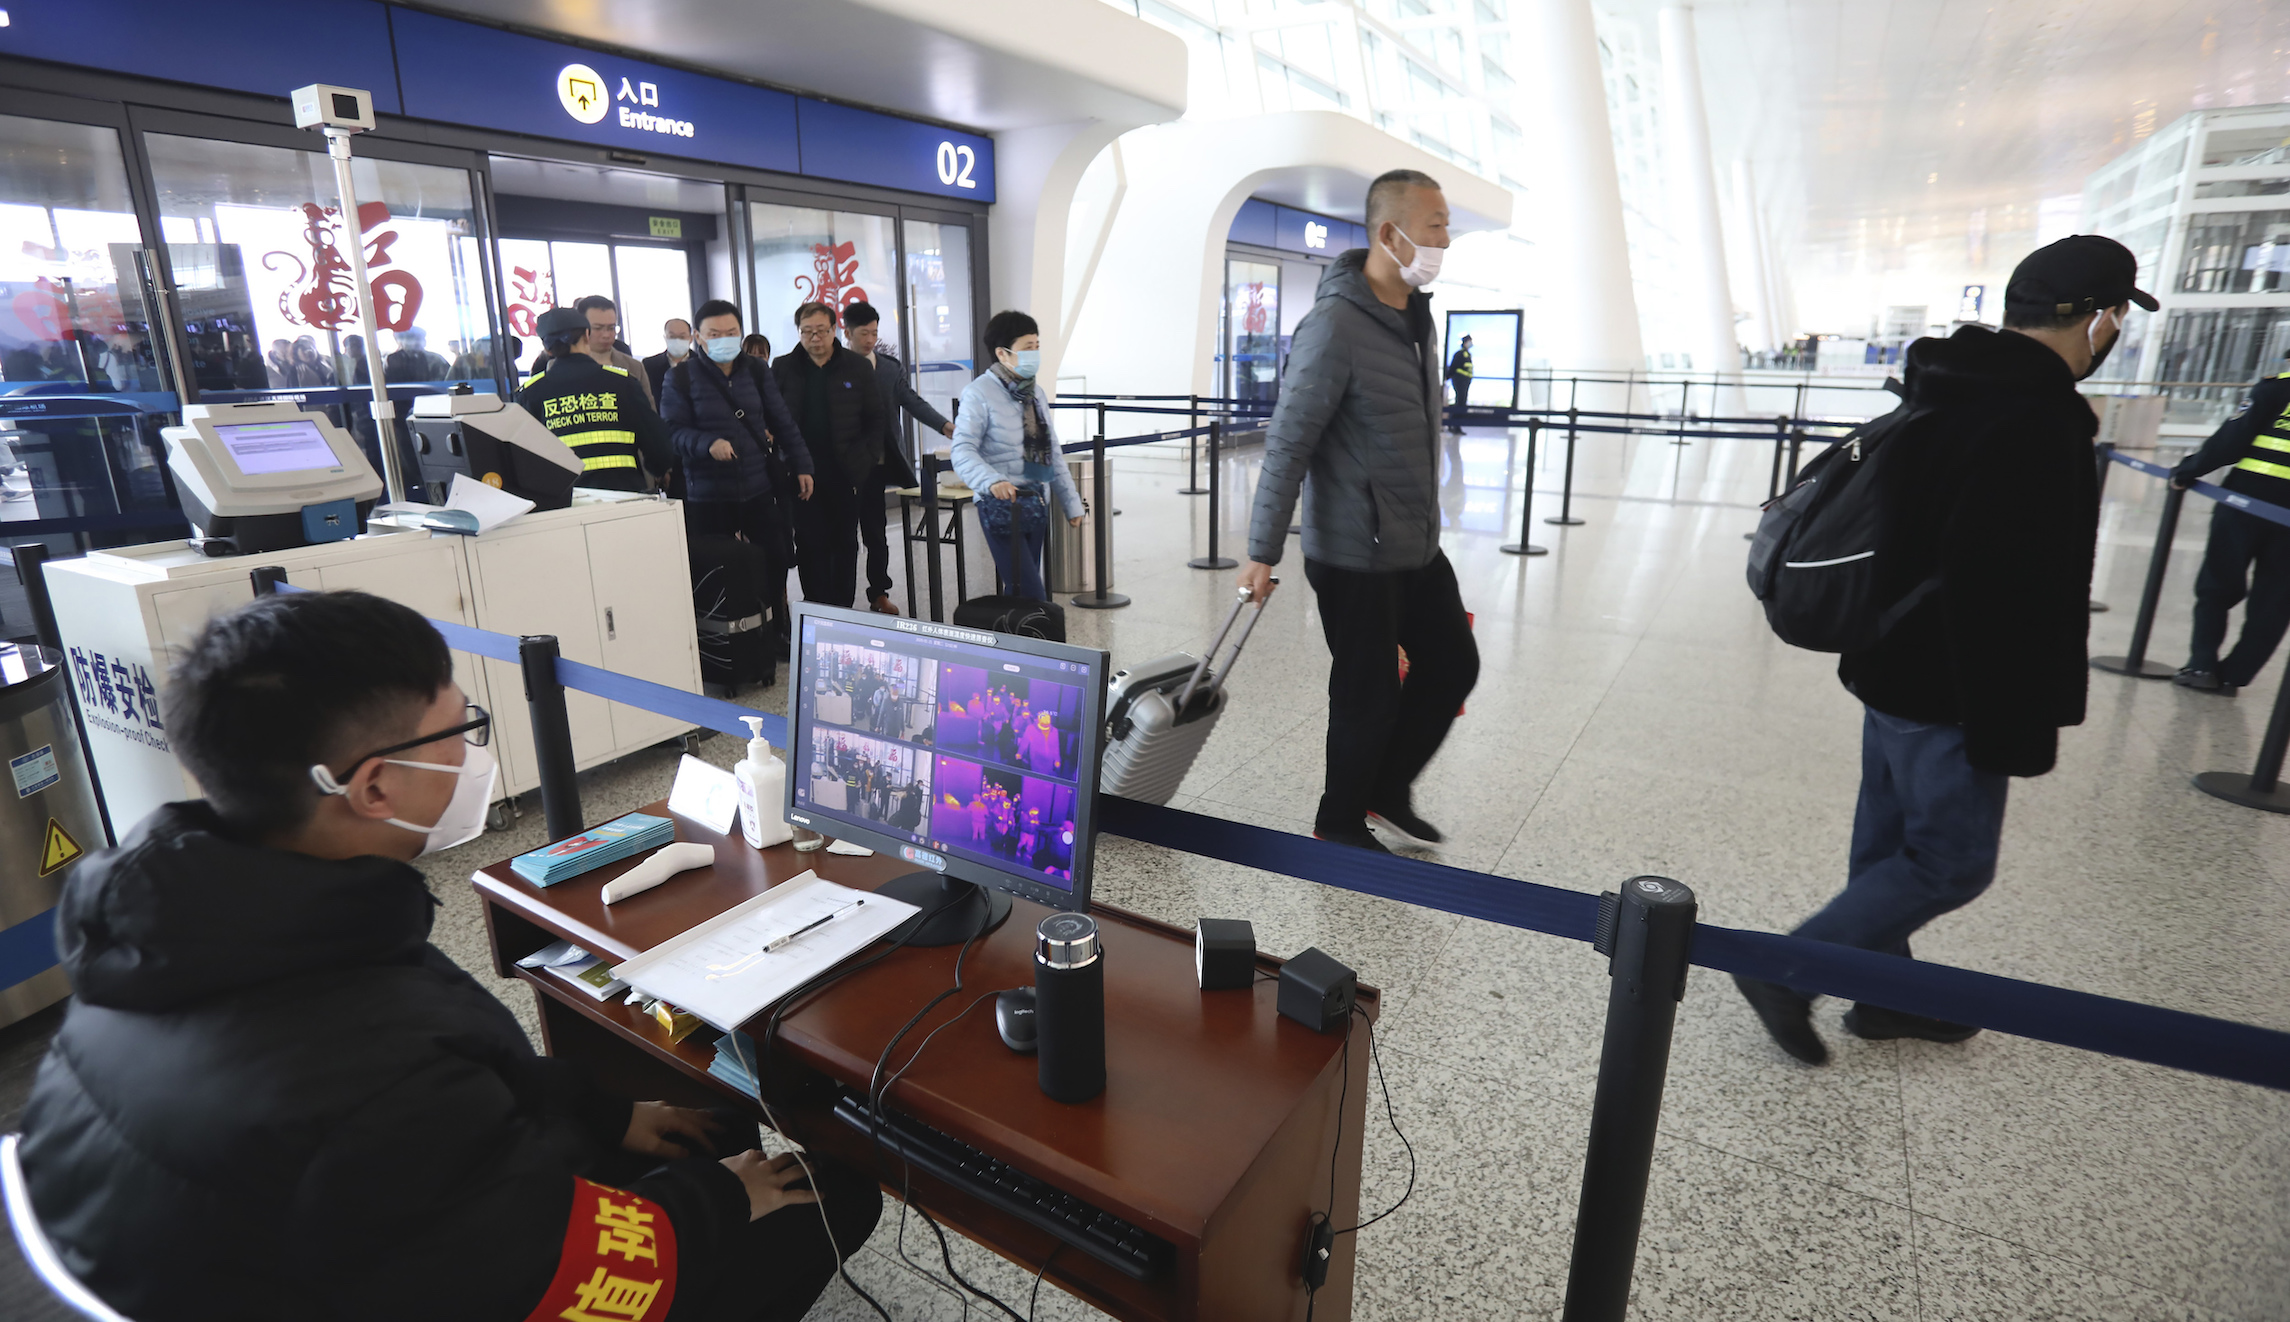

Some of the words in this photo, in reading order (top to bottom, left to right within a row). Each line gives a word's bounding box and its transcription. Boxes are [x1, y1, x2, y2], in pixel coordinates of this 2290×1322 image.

[617, 76, 659, 108] 入口
[618, 106, 695, 138] Entrance
[936, 141, 977, 189] 02
[543, 392, 618, 418] 反恐检查
[545, 415, 573, 430] CHECK
[572, 412, 586, 424] ON
[586, 411, 619, 423] TERROR
[896, 620, 918, 632] IR236
[69, 646, 165, 731] 防爆安检
[144, 730, 171, 754] Check
[790, 812, 811, 825] Lenovo
[1013, 1008, 1034, 1016] logitech
